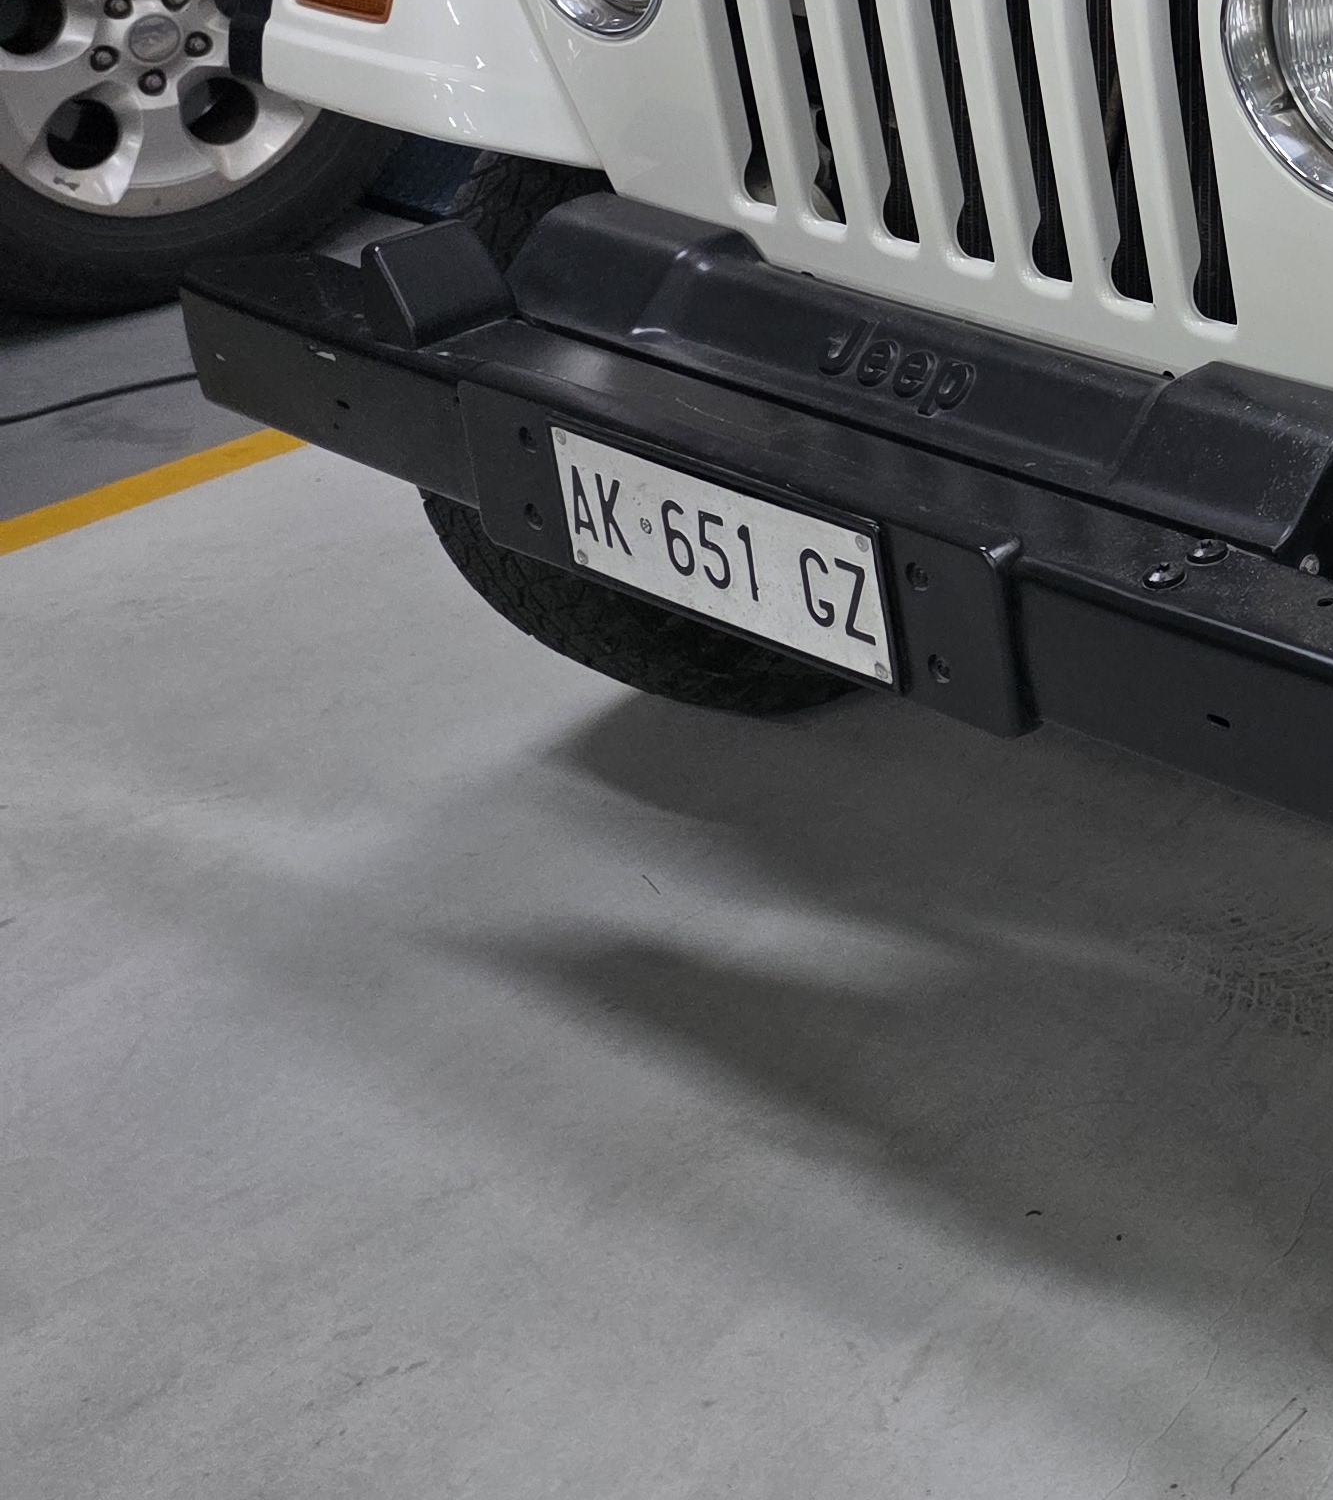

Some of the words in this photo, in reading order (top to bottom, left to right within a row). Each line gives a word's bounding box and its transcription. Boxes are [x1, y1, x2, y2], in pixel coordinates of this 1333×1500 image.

[817, 318, 977, 418] Jeep
[571, 464, 633, 557] AK
[660, 499, 760, 602] 651
[799, 547, 877, 647] GZ
